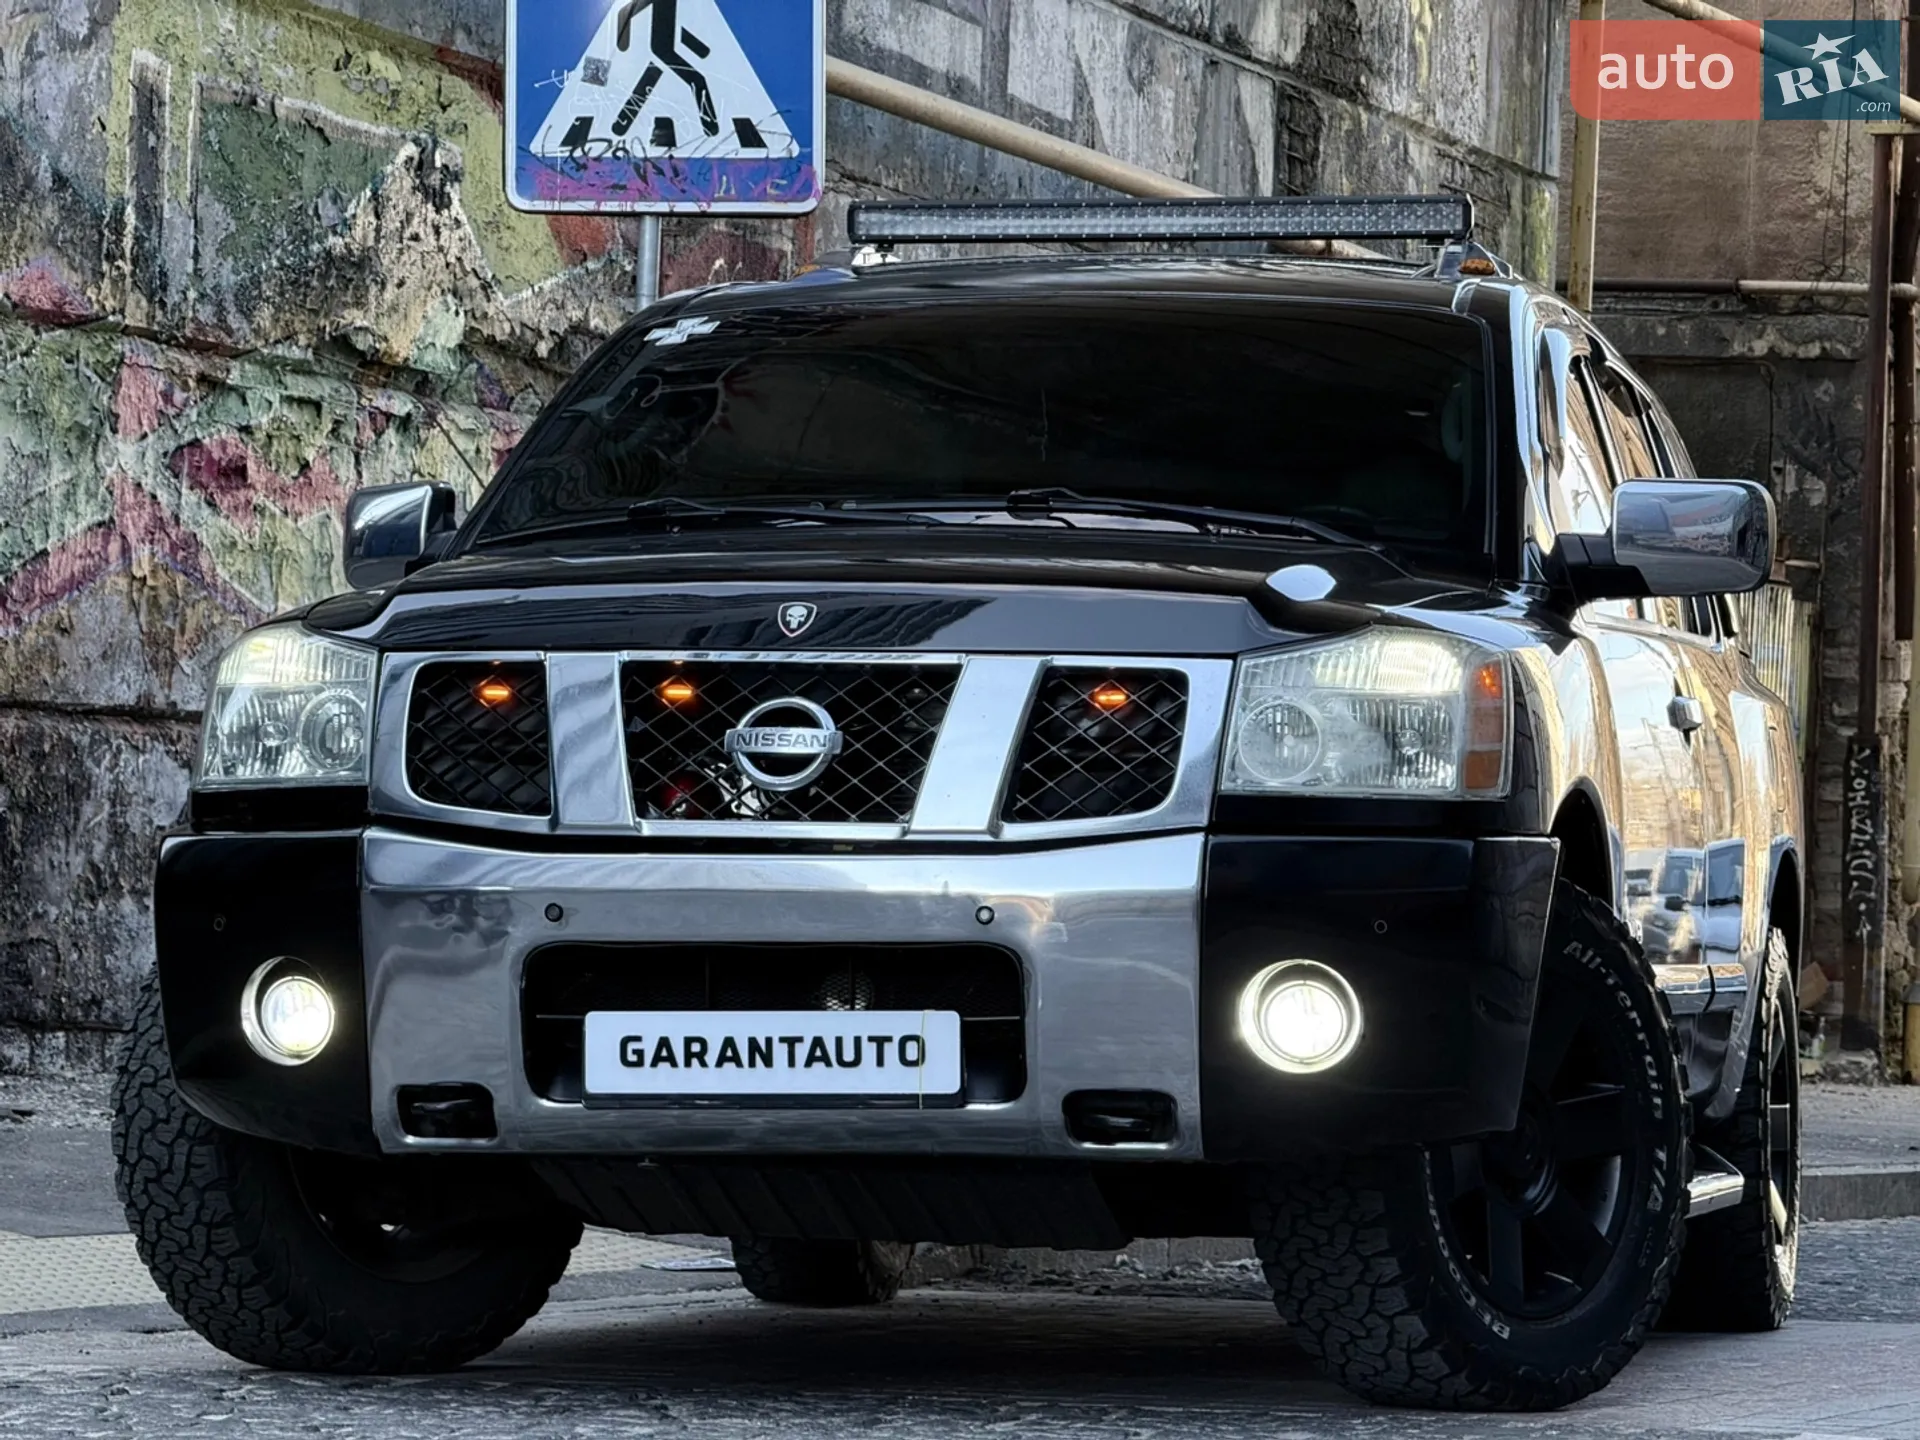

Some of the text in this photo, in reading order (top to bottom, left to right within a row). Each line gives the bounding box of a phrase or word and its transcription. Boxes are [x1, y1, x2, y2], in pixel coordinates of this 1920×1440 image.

[735, 732, 829, 748] NISSAN
[619, 1034, 926, 1068] GARANTAUTO
[1420, 1143, 1511, 1340] BFGoodri
